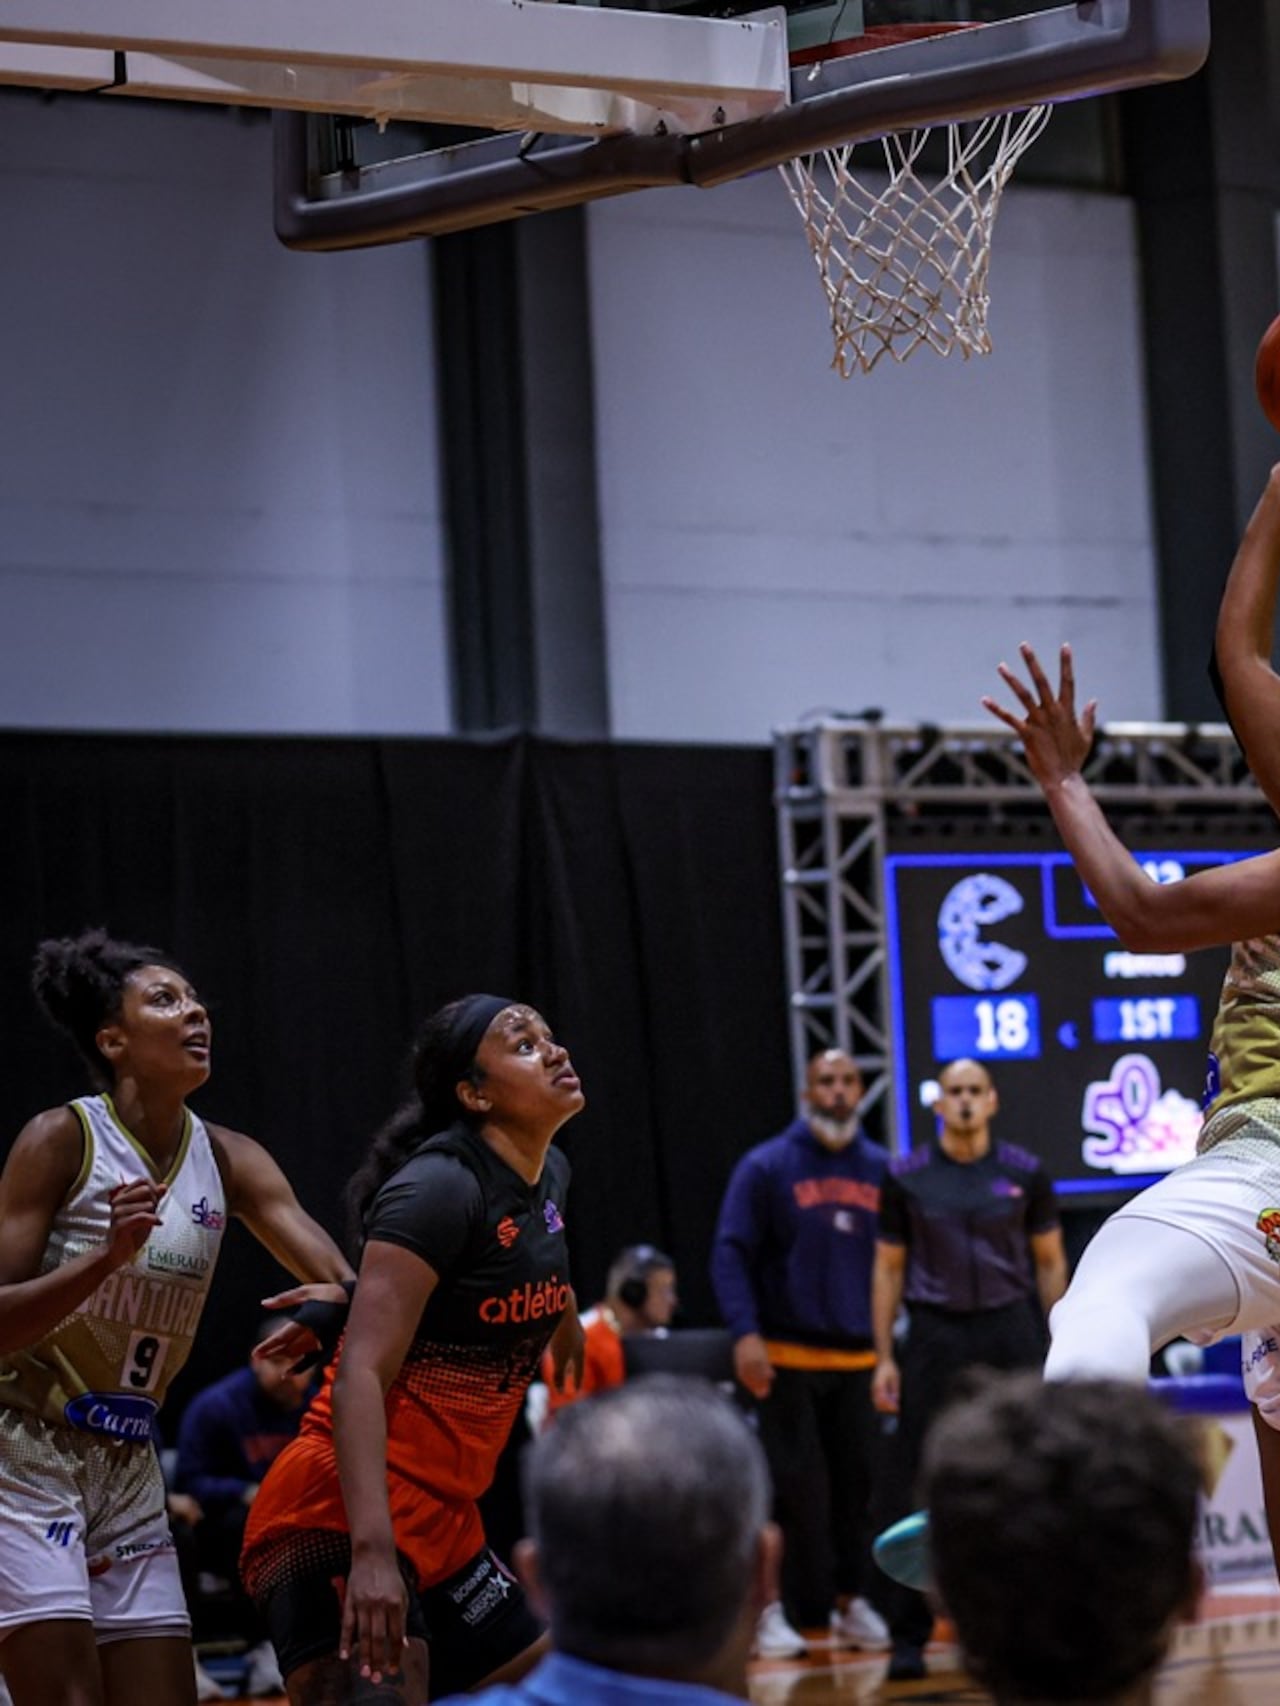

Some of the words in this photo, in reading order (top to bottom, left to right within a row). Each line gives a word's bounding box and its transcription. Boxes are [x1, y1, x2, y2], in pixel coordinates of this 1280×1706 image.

[975, 1000, 1030, 1052] 18
[1119, 1000, 1176, 1039] 1ST
[78, 1272, 206, 1339] ANTUR
[479, 1275, 569, 1323] atlétic
[130, 1336, 160, 1388] 9
